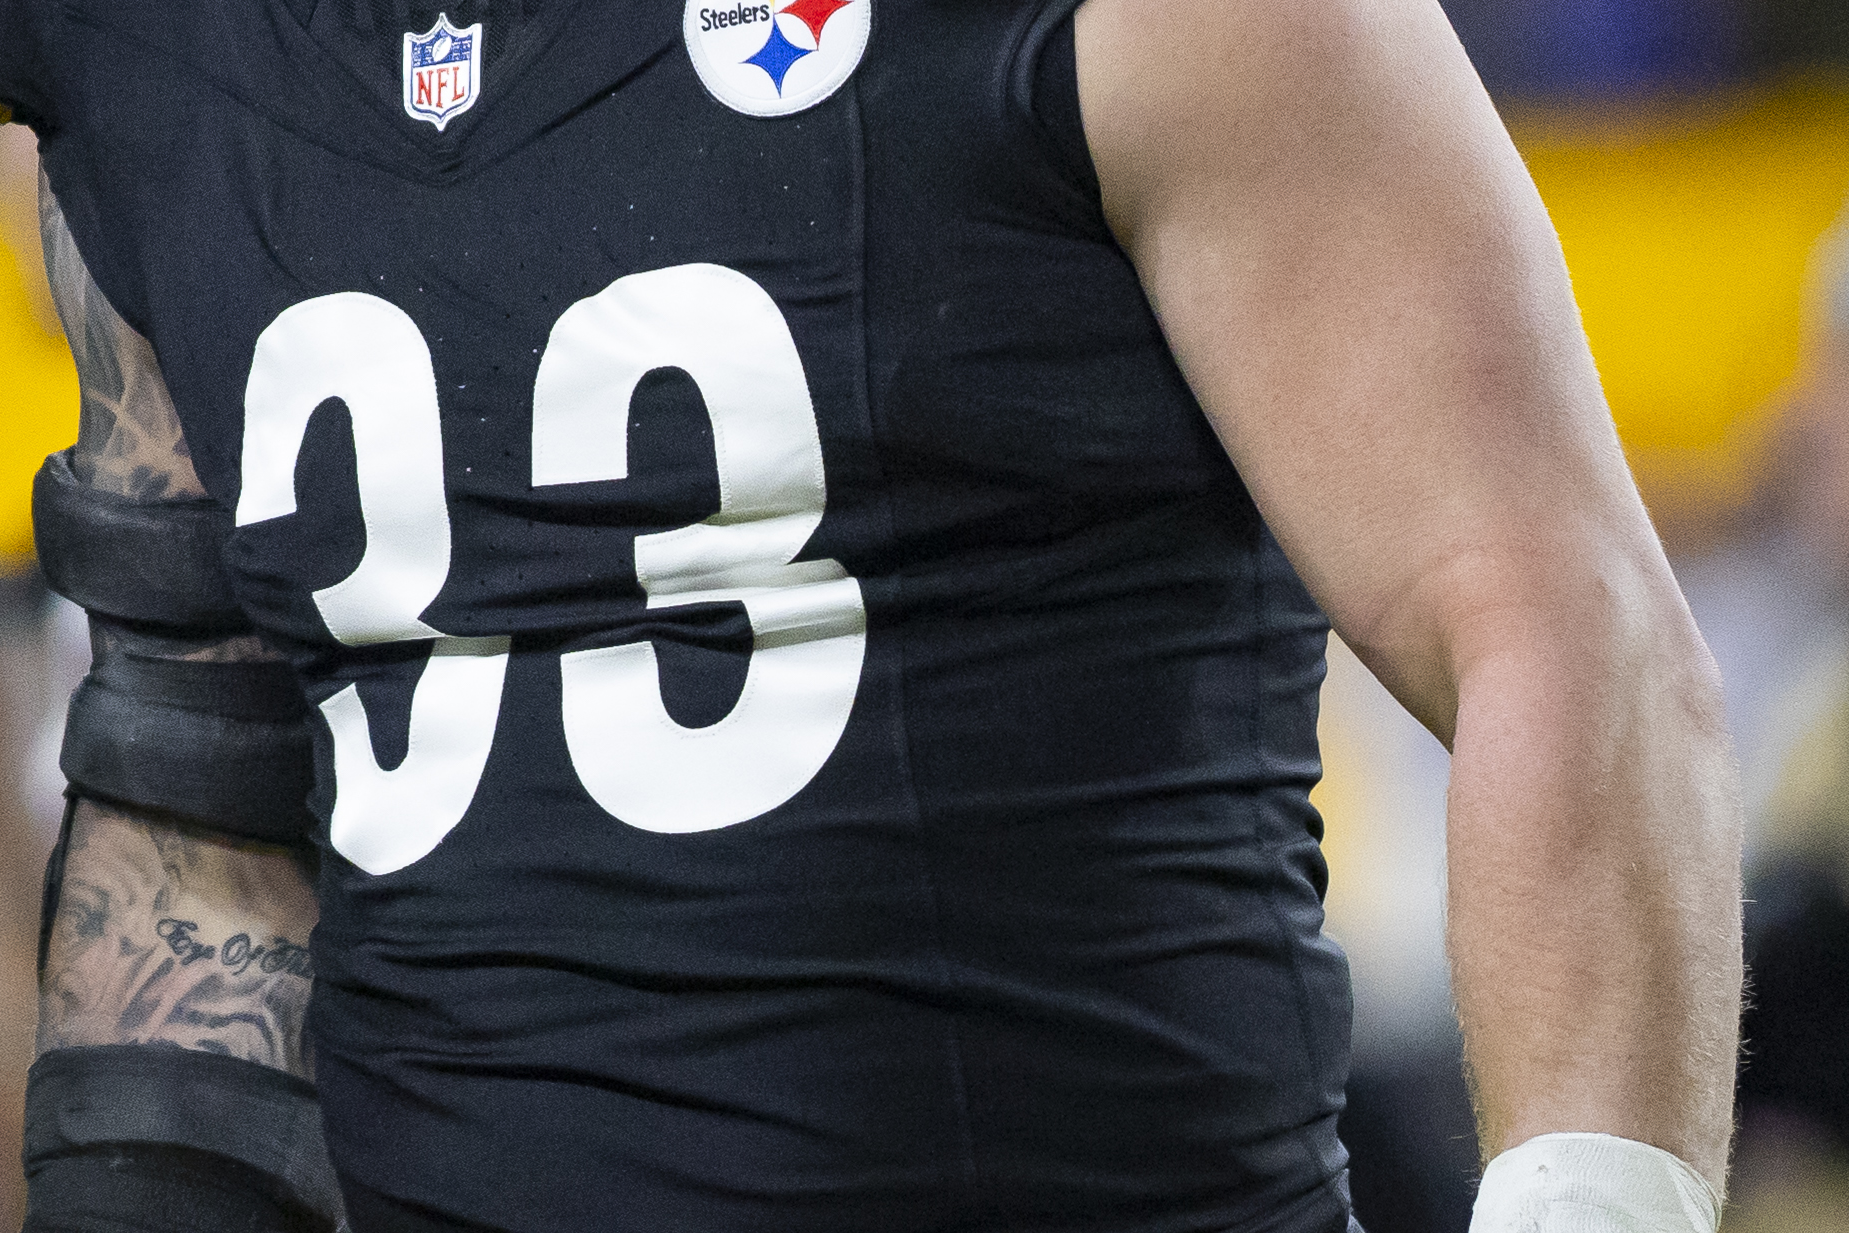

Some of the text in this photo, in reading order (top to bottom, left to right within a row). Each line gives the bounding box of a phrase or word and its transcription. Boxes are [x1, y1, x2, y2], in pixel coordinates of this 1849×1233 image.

[699, 2, 771, 33] Steelers
[415, 66, 466, 109] NFL
[235, 262, 867, 877] 33
